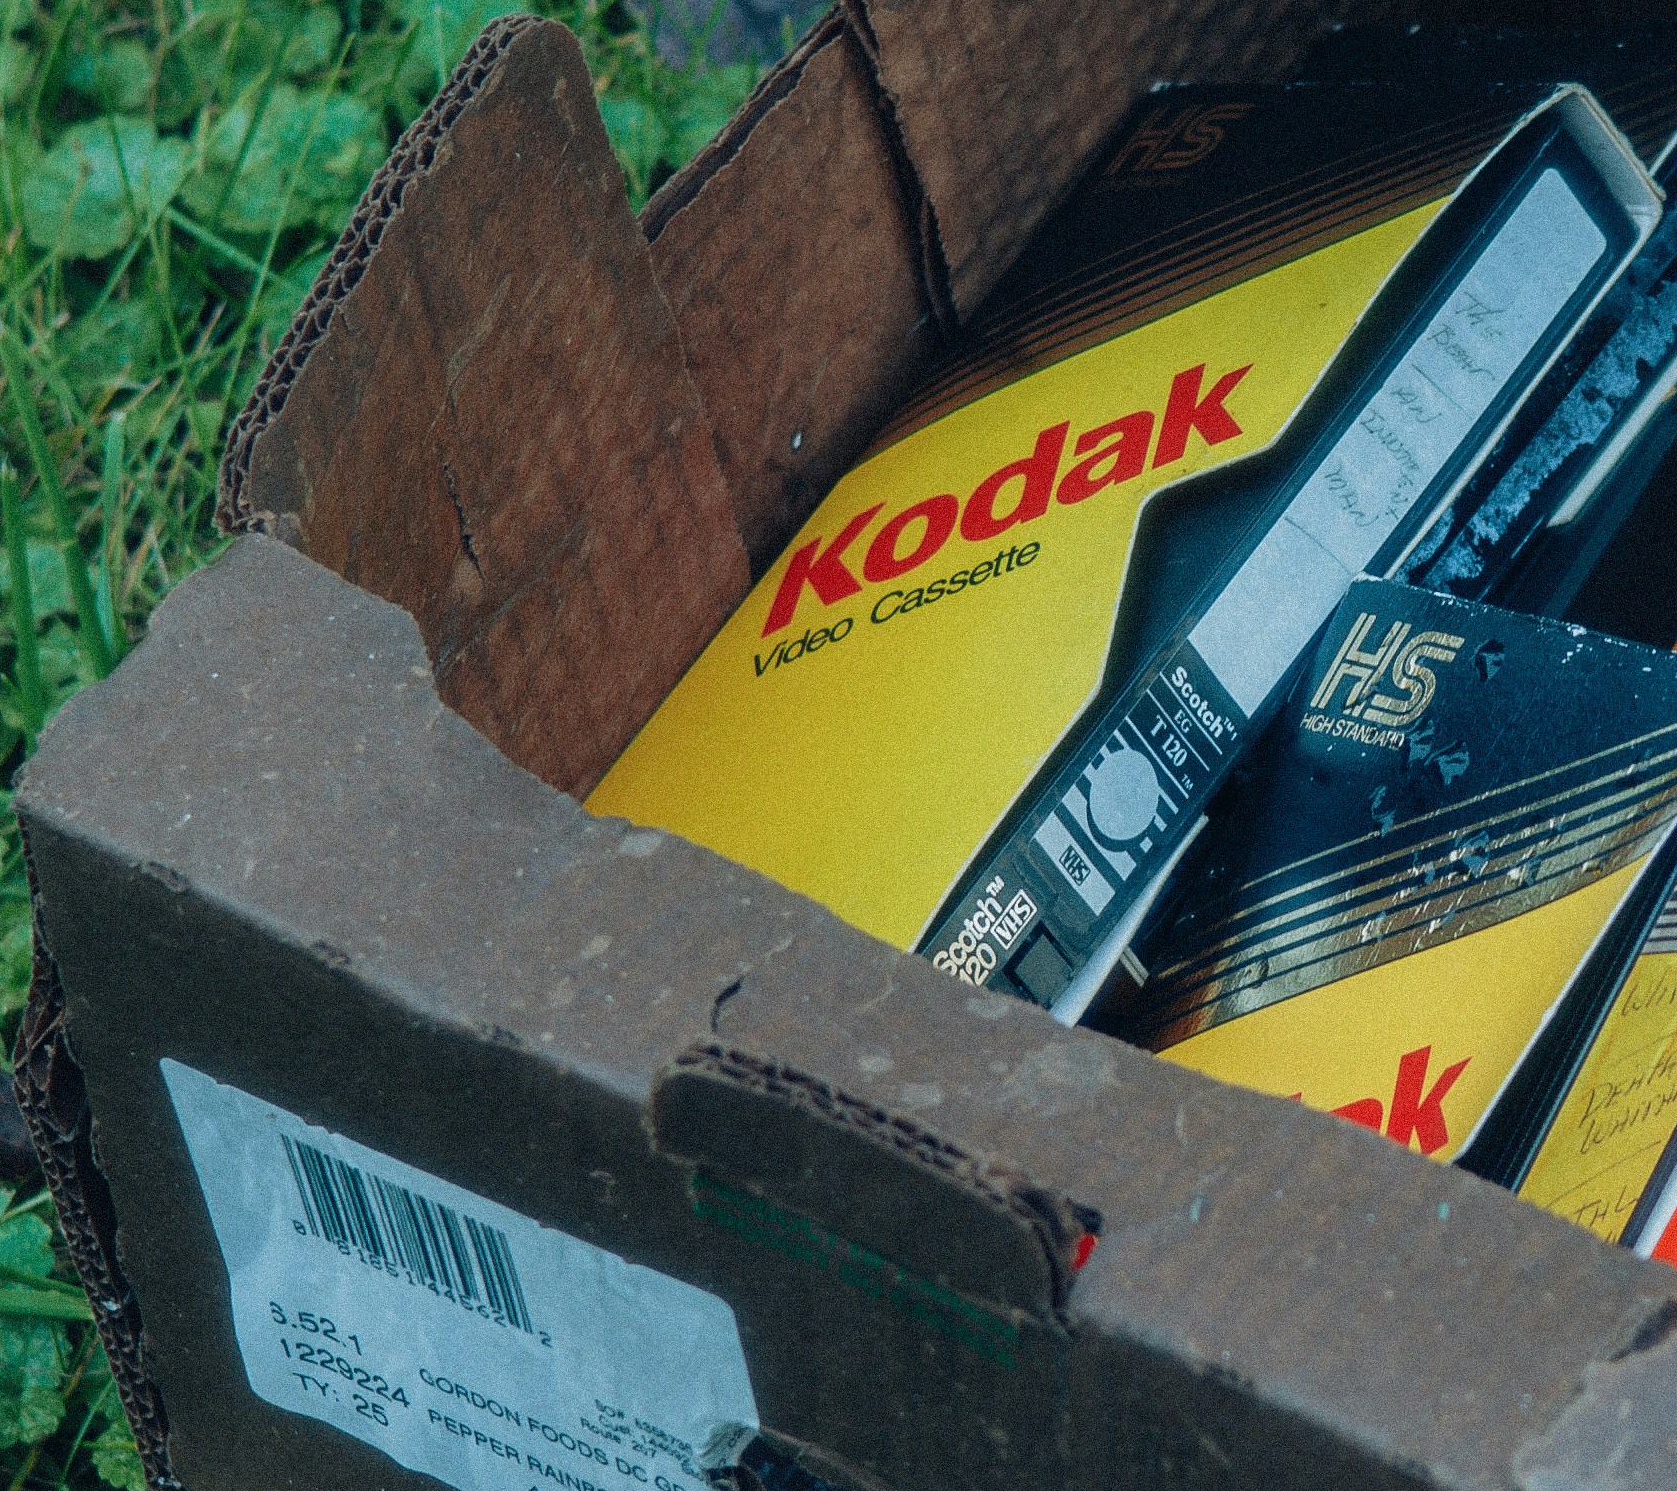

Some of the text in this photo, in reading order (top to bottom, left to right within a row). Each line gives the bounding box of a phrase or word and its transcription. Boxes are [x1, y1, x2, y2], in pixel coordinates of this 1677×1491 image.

[759, 361, 1254, 639] Kodak
[753, 539, 1042, 678] Video Cassette
[1309, 612, 1465, 727] HS
[1147, 714, 1188, 768] T 120
[1174, 709, 1192, 735] EG
[1299, 712, 1406, 751] HIGH STANDARD
[1060, 847, 1091, 887] VHS
[995, 892, 1037, 946] VHS
[281, 1338, 411, 1408] 1229224
[353, 1394, 389, 1427] 25
[419, 1368, 522, 1427] GORDON
[527, 1416, 609, 1466] FOODS
[615, 1456, 648, 1483] DC
[427, 1409, 522, 1465] PEPPER
